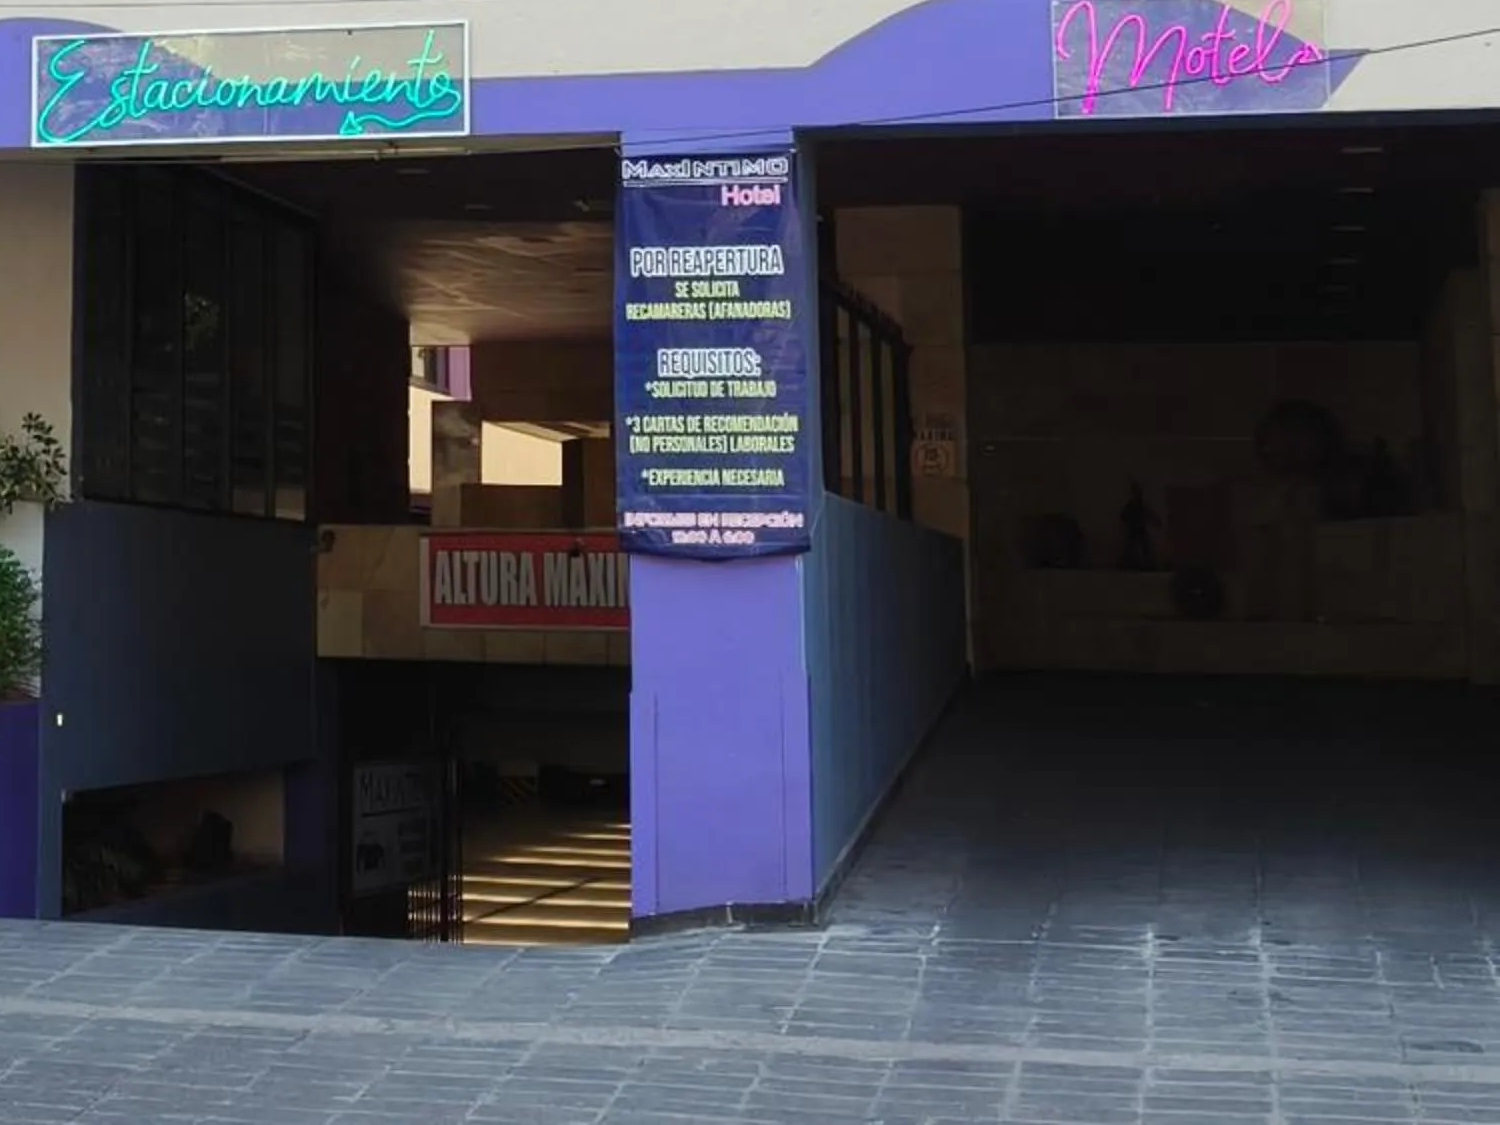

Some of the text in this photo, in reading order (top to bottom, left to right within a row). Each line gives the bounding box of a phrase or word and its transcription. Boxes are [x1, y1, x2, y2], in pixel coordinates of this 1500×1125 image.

[37, 28, 461, 145] Estacionamiento
[721, 184, 781, 206] Hotel
[630, 245, 785, 277] POR REAPERTURA
[674, 280, 741, 298] SE SOLICITA
[657, 347, 762, 378] REQUISITOS:
[709, 380, 726, 397] DE
[727, 379, 777, 397] TRABAJO
[642, 416, 685, 433] CARTAS
[686, 415, 702, 433] DE
[729, 435, 796, 453] LABORALES
[721, 468, 785, 486] NECESARIA
[435, 550, 538, 606] ALTURA
